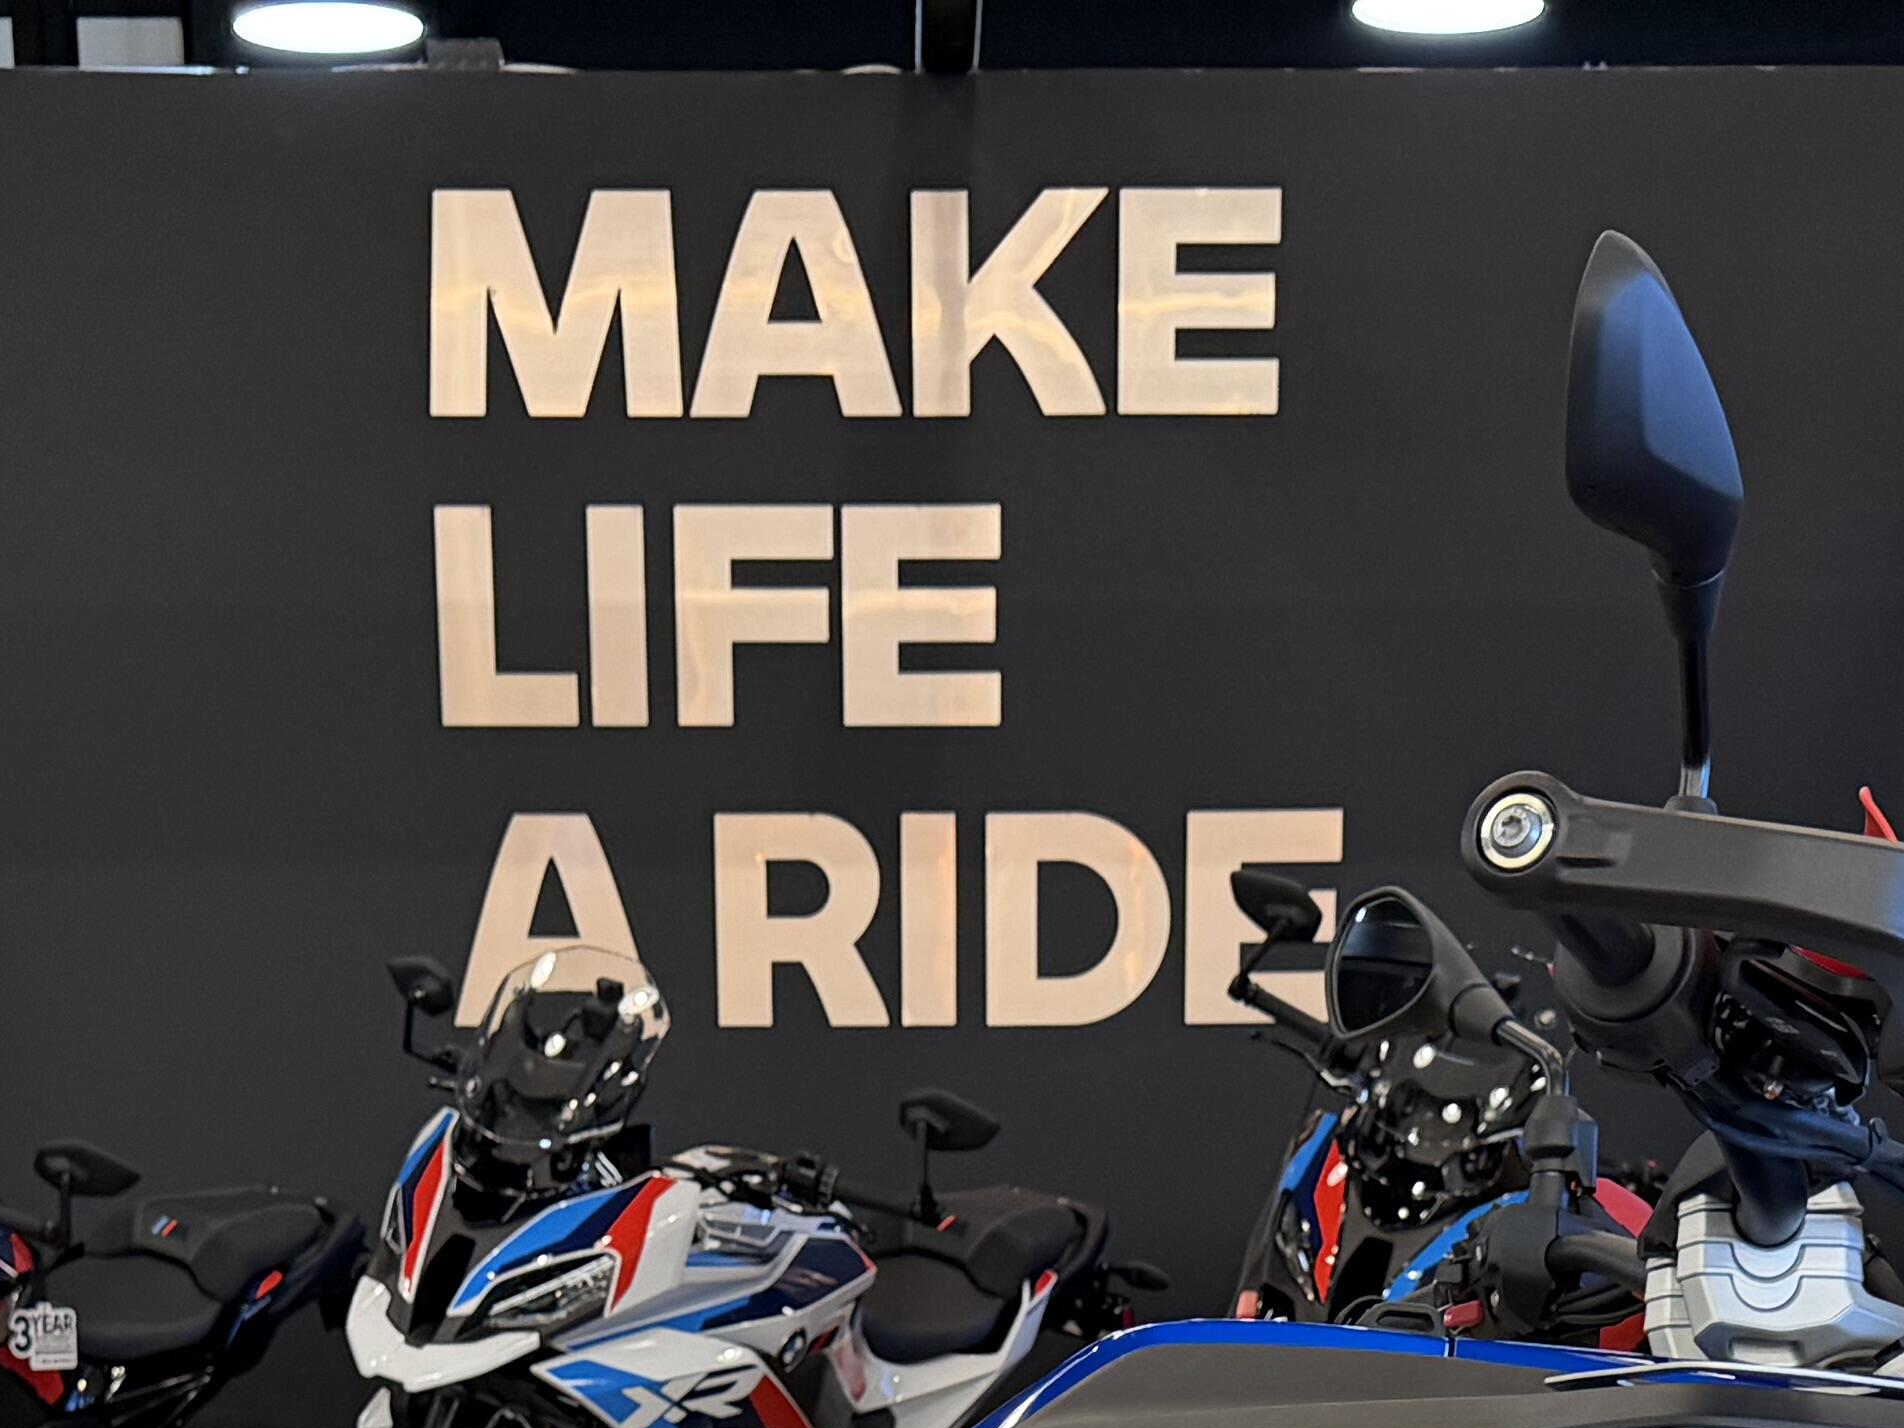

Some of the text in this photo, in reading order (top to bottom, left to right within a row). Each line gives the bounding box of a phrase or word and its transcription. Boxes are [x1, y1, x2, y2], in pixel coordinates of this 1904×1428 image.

[429, 187, 1283, 418] MAKE
[433, 502, 1002, 727] LIFE
[453, 807, 1345, 1028] A RIDE
[15, 1313, 72, 1352] 3 YEAR
